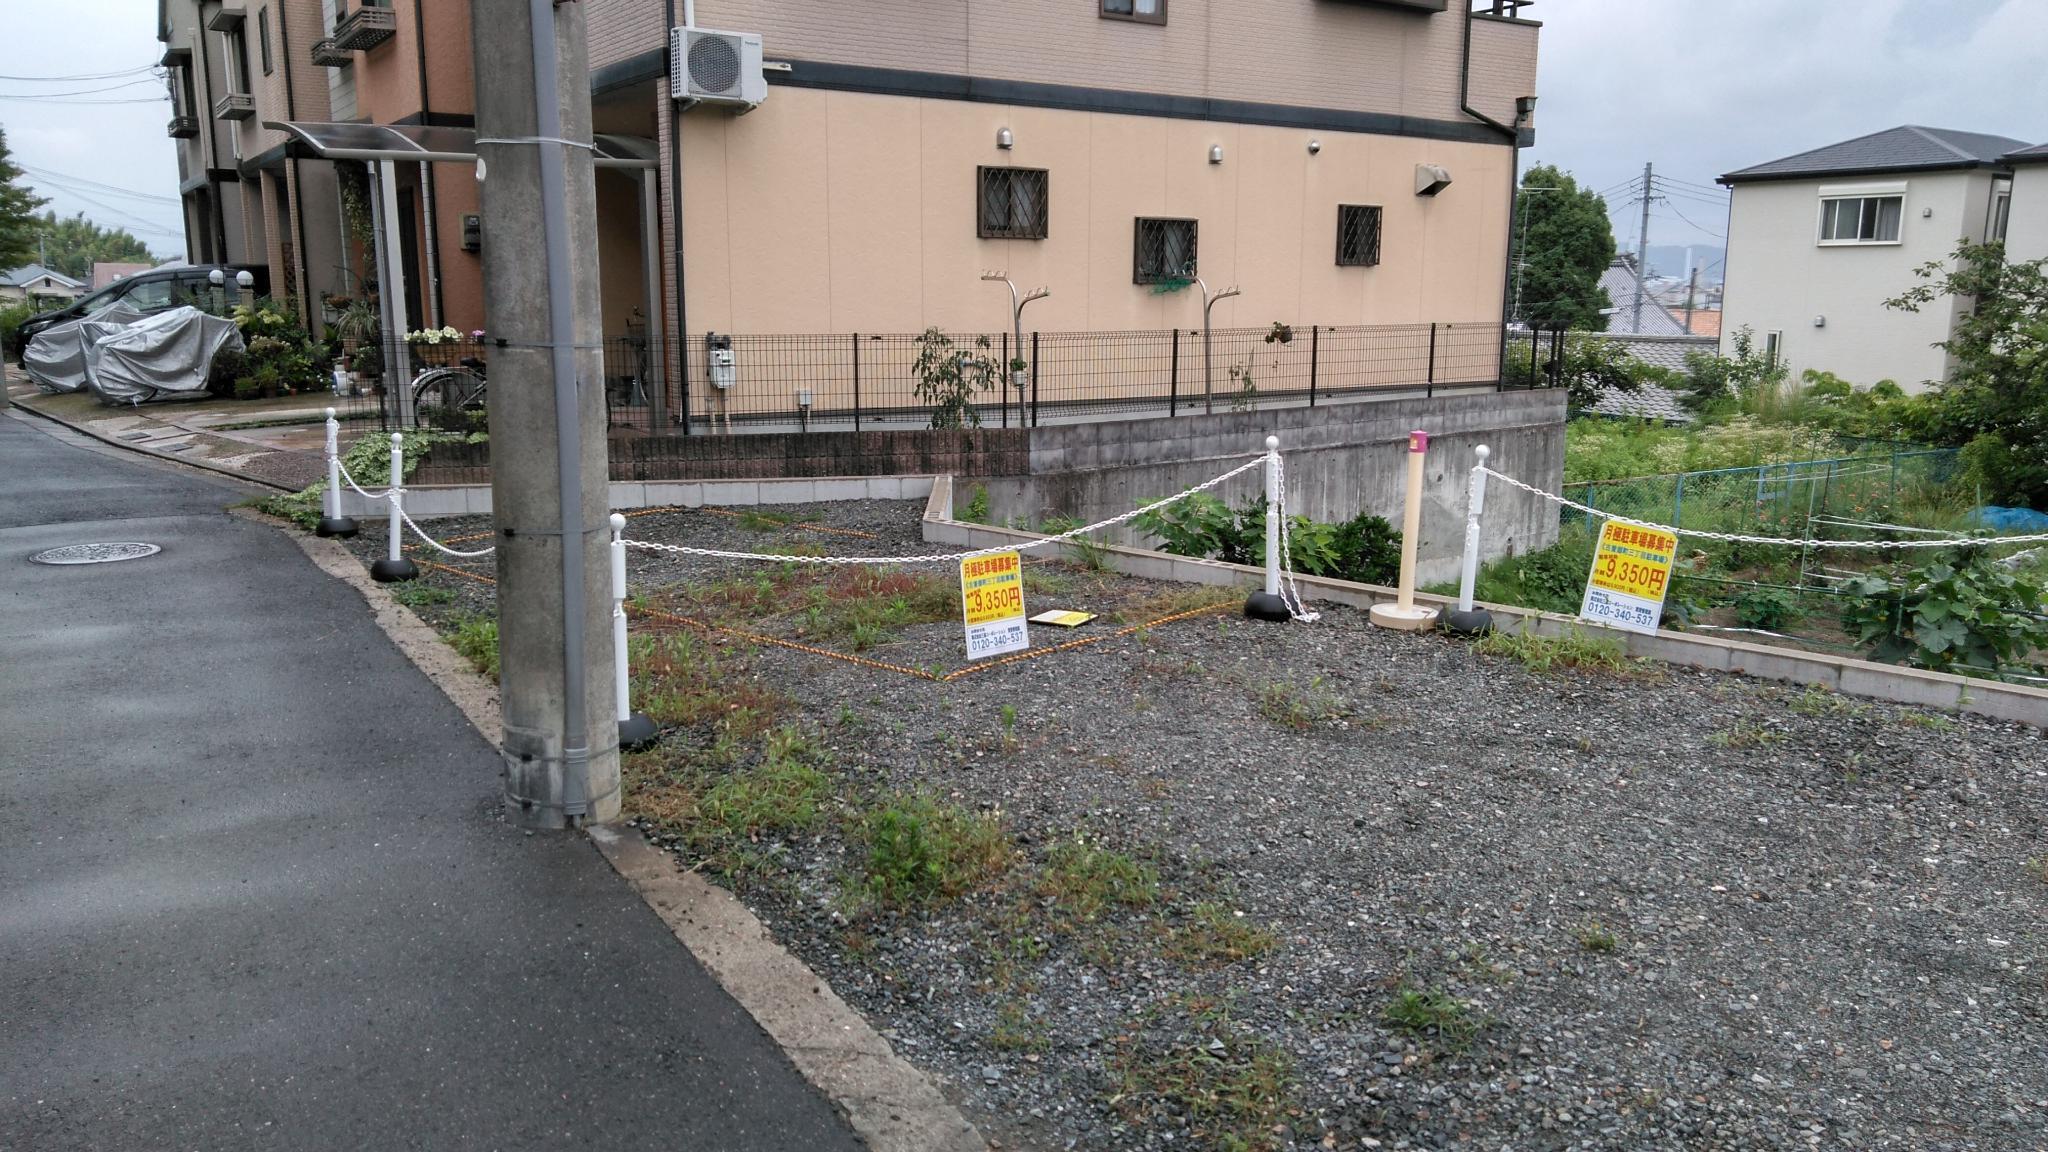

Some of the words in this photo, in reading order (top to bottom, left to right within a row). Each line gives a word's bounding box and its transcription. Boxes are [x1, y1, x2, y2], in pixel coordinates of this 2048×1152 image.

[1604, 525, 1675, 553] 月極駐車場募集中
[964, 557, 1019, 578] 月極駐車場募集中
[1606, 559, 1666, 591] 9,350円
[975, 586, 1021, 613] 9,350円
[1588, 602, 1653, 626] 0120-340-537
[972, 631, 1023, 651] 0120-340-537
